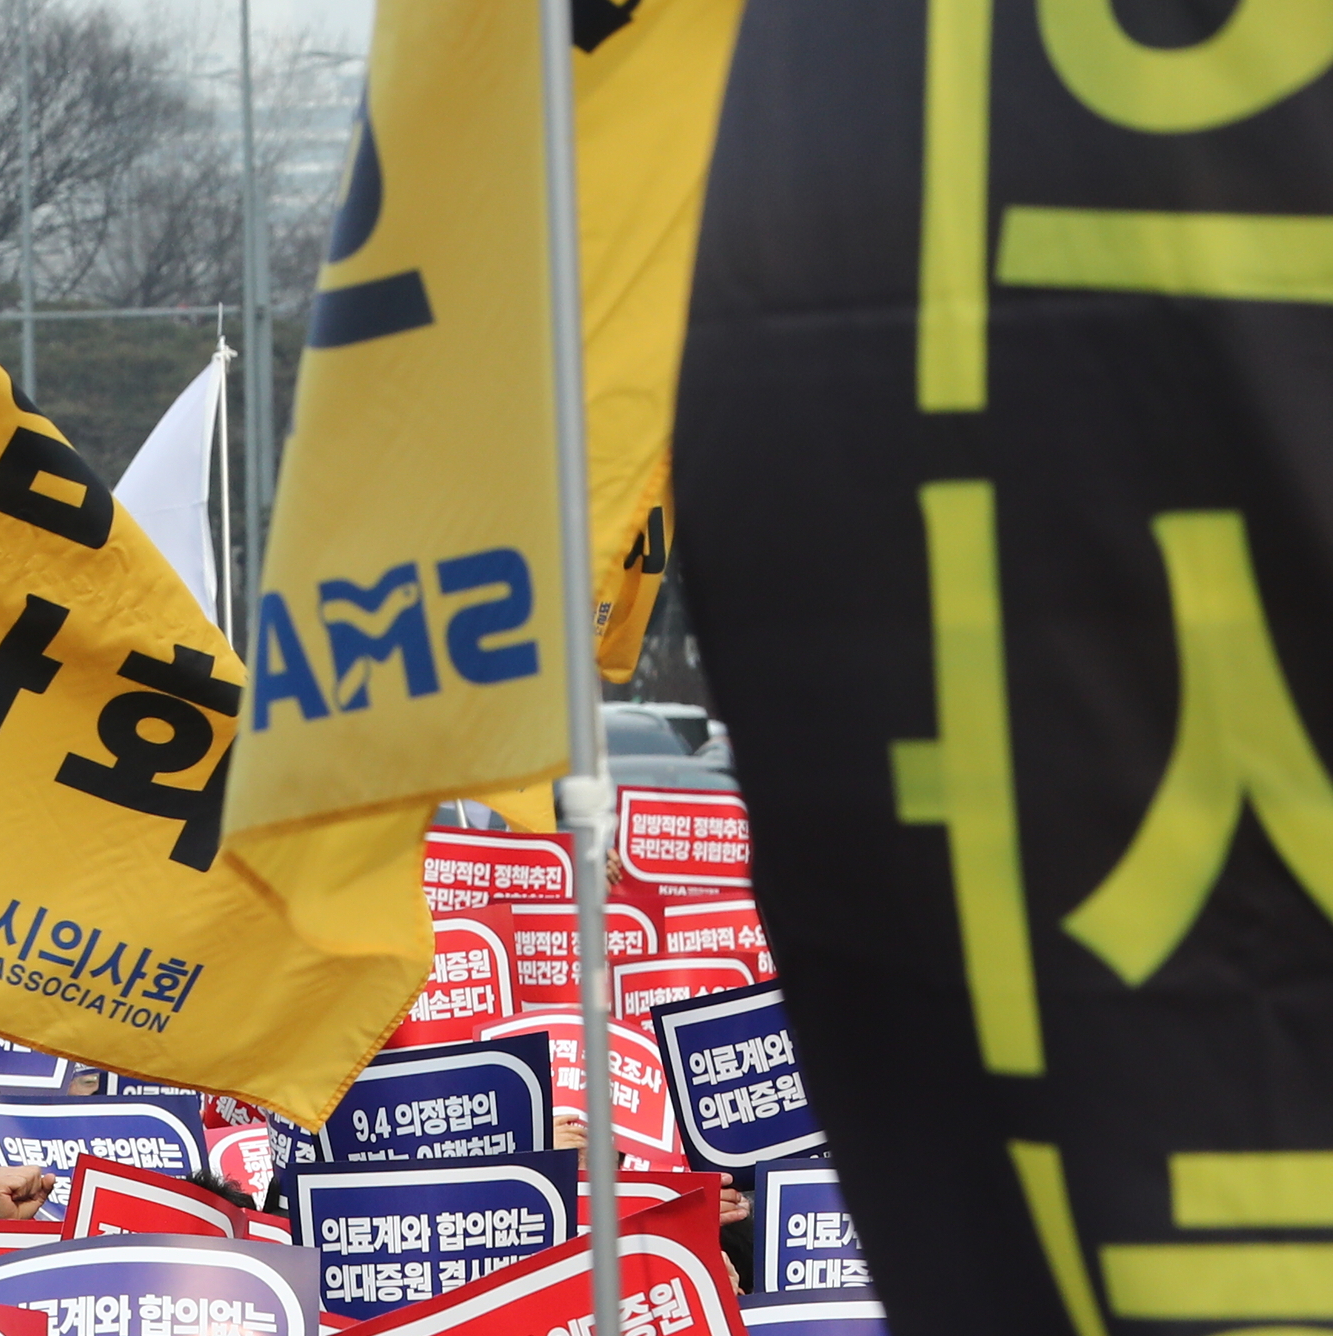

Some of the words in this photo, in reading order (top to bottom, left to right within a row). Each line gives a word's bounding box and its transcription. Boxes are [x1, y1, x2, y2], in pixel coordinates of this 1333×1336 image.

[633, 814, 691, 836] 일방적인
[694, 817, 749, 839] 정책추진
[630, 839, 689, 859] 국민건강
[692, 842, 751, 863] 위협한다
[424, 859, 490, 887] 일방적인
[493, 863, 561, 890] 정책추진
[666, 927, 734, 953] 비과학적
[689, 1030, 794, 1086] 의료계와
[352, 1108, 392, 1144] 9.4
[395, 1090, 499, 1137] 의정합의
[699, 1072, 808, 1130] 의대증원
[322, 1212, 431, 1256] 의료계와
[436, 1207, 546, 1252] 합의없는
[325, 1262, 432, 1303] 의대증원
